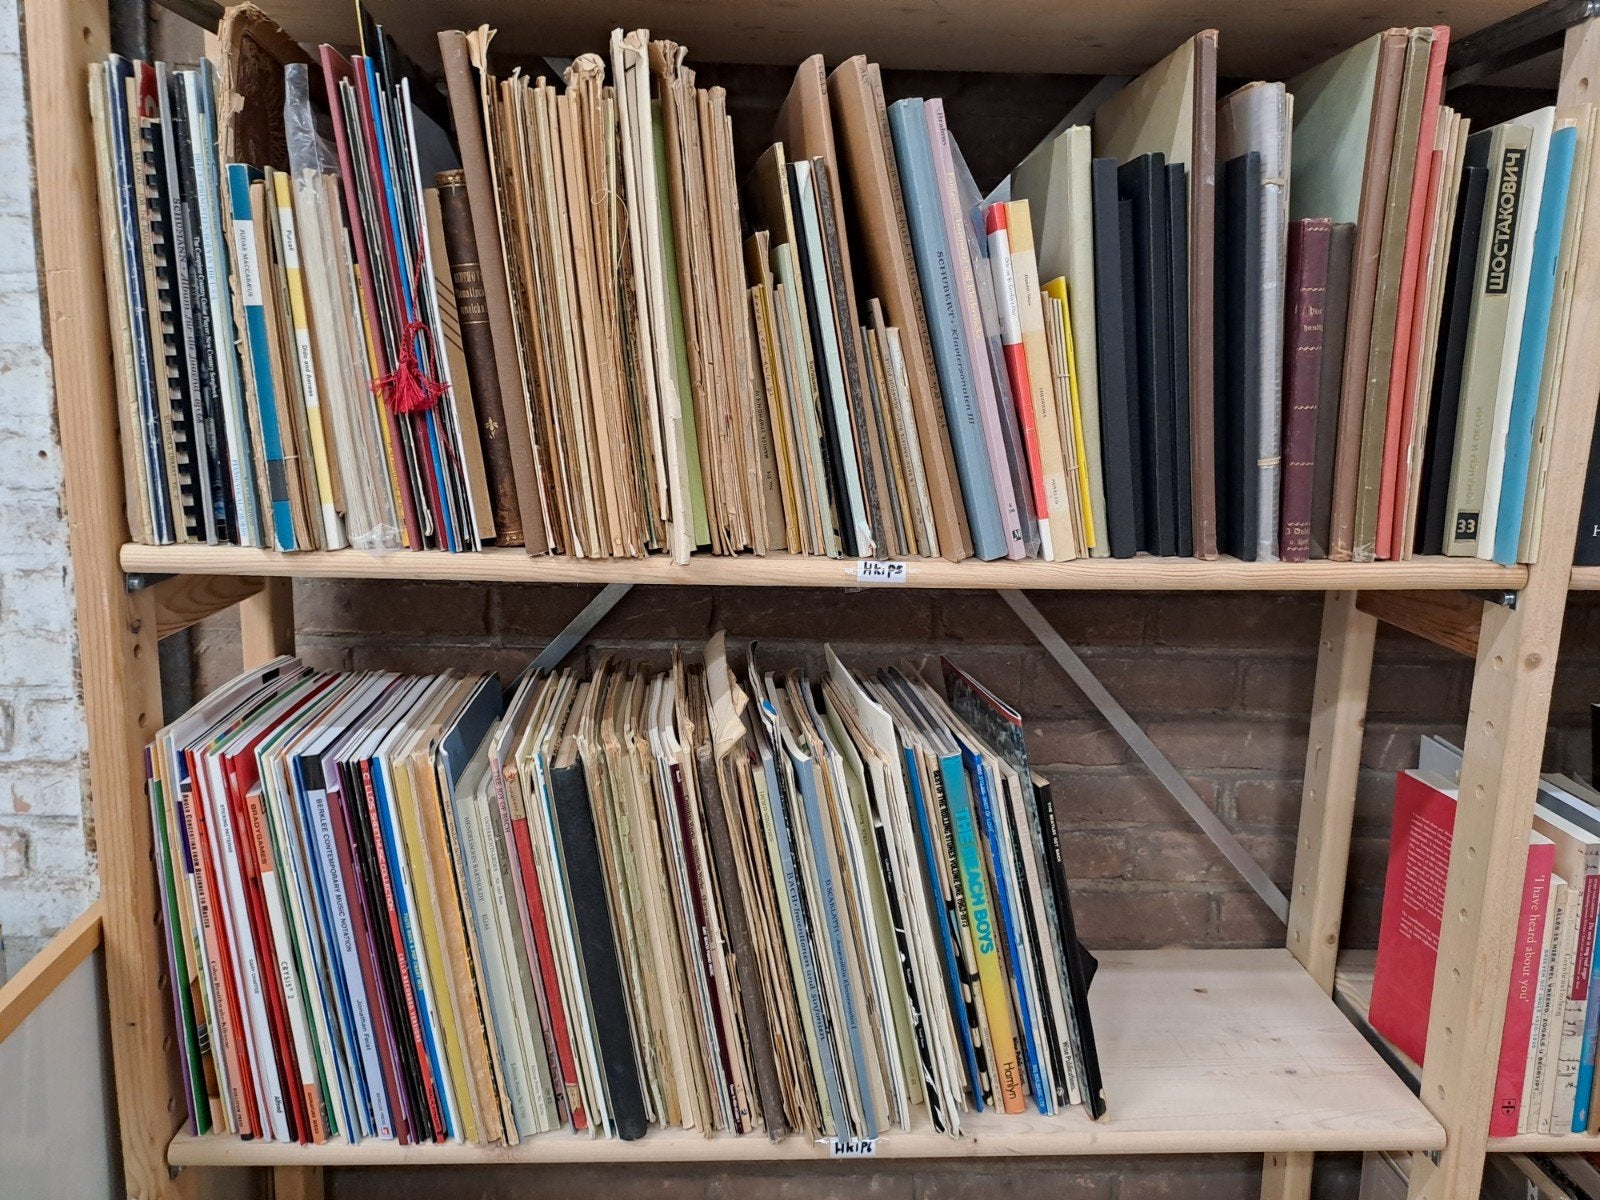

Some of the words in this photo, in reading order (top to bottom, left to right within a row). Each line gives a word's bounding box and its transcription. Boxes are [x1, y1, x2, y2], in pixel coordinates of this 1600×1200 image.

[817, 65, 826, 95] CELLO
[936, 111, 947, 146] Brahms
[172, 197, 186, 263] SCHUMANN
[1488, 150, 1521, 291] ШОСТАКОВИЧ
[192, 235, 200, 248] The
[238, 228, 248, 251] JUDAS
[284, 228, 295, 252] Purcell
[193, 247, 203, 274] Complete
[197, 274, 206, 297] Country
[935, 249, 955, 320] SCHUBERT
[950, 327, 973, 412] Klaviersonaten
[966, 412, 975, 426] III
[300, 343, 310, 360] Dido
[303, 359, 311, 373] and
[304, 372, 316, 398] Aeneas
[1457, 519, 1475, 533] 33
[932, 768, 943, 787] BEST
[935, 785, 945, 796] OF
[499, 801, 508, 812] OF
[937, 794, 947, 809] THE
[1045, 800, 1054, 813] THE
[218, 803, 229, 828] STICKING
[315, 797, 329, 833] BERKLEE
[501, 812, 512, 833] BACH
[939, 807, 952, 835] ROLLING
[952, 807, 975, 845] THE
[1048, 813, 1058, 836] BEATLES
[223, 827, 234, 854] PATTERNS
[248, 802, 269, 865] BRADYGAMES
[944, 833, 957, 860] STONES
[1052, 835, 1060, 847] GET
[322, 833, 341, 893] CONTEMPORARY
[462, 815, 478, 863] MENDELSSOHN
[471, 863, 485, 903] BARTHOLDY
[1054, 847, 1063, 863] BACK
[949, 858, 961, 884] VOLUME
[960, 845, 987, 907] BEACH
[785, 871, 798, 904] BACH
[953, 882, 964, 898] ONE
[1529, 885, 1544, 912] have
[334, 893, 346, 917] MUSIC
[825, 886, 840, 933] SCARLATTI
[481, 912, 490, 931] ELIAS
[971, 907, 996, 955] BOYS
[1525, 913, 1541, 945] heard
[1553, 906, 1563, 931] ALLES
[339, 917, 353, 953] NOTATION
[792, 907, 811, 968] Inventionen
[1552, 932, 1559, 940] IS
[397, 952, 408, 974] CELLO
[1521, 945, 1537, 977] about
[1549, 942, 1558, 962] HIER
[805, 969, 816, 990] und
[1547, 964, 1555, 981] WEL
[355, 998, 369, 1032] Jonathan
[362, 1032, 372, 1051] Feist
[809, 991, 826, 1041] Sinfonien
[1538, 1017, 1548, 1047] ZOOALS
[1061, 1039, 1071, 1056] Wise
[999, 1060, 1022, 1100] Hamlyn
[272, 1094, 283, 1114] Alfred
